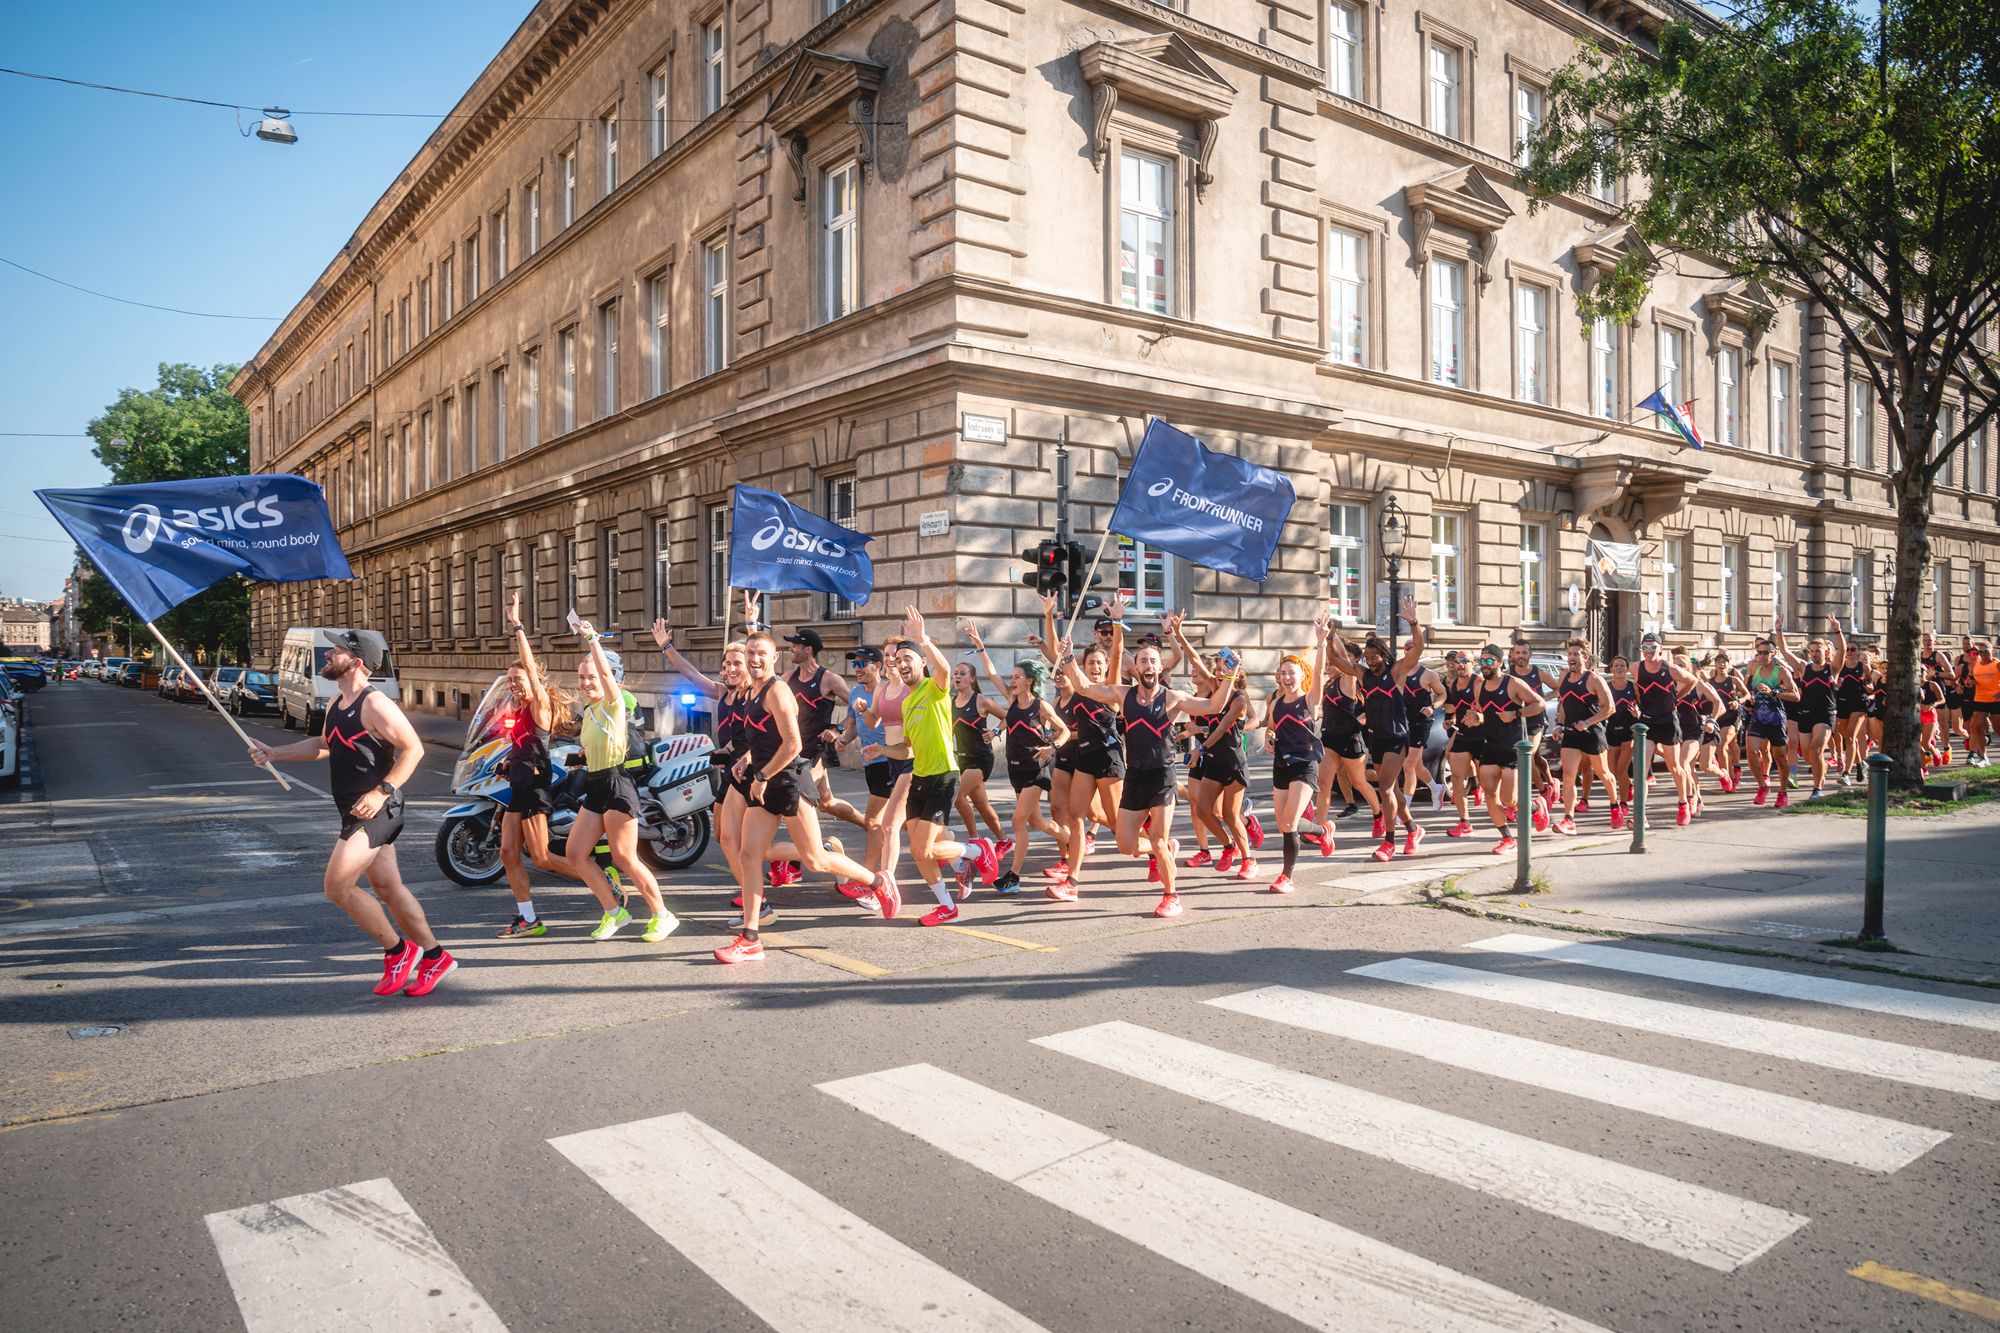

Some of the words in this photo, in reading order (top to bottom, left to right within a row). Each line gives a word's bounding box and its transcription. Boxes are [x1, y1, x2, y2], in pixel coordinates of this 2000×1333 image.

[1172, 488, 1263, 533] FRONTRUNNER
[181, 536, 213, 549] soud
[251, 535, 287, 549] sound
[289, 532, 320, 546] body
[814, 561, 839, 572] sound
[839, 566, 859, 578] body
